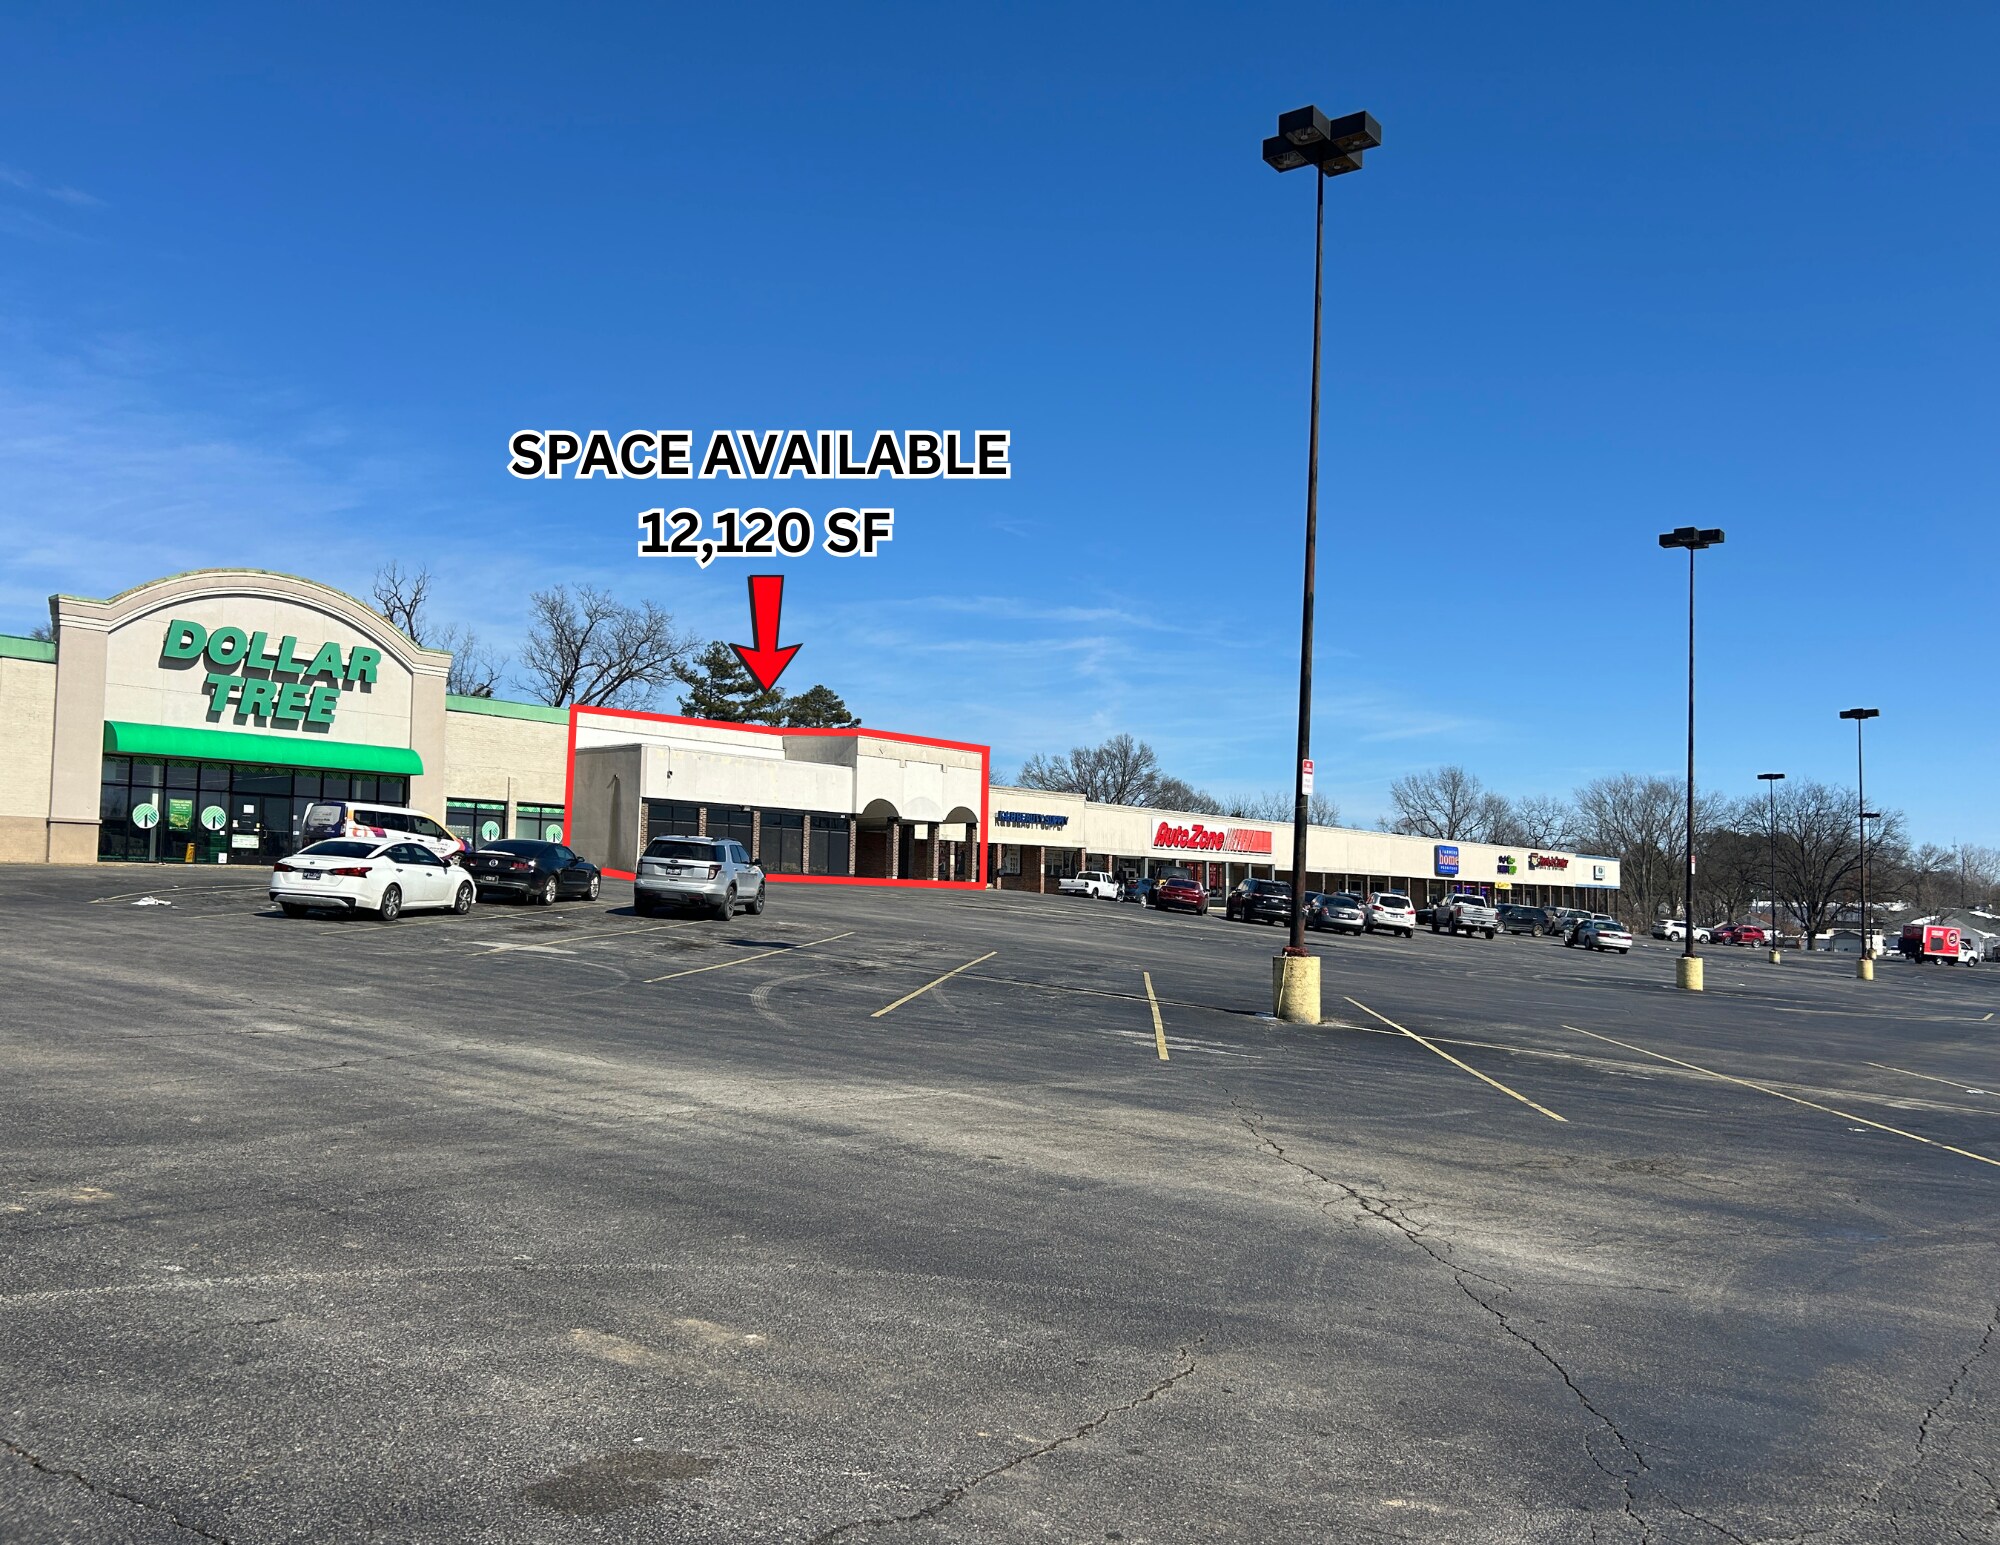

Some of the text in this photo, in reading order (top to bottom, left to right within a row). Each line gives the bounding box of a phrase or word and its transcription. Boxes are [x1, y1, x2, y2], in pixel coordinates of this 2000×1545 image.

[163, 619, 381, 684] DOLLAR
[205, 673, 341, 724] TREE
[1153, 821, 1225, 851] AutoZone
[1439, 849, 1459, 865] home
